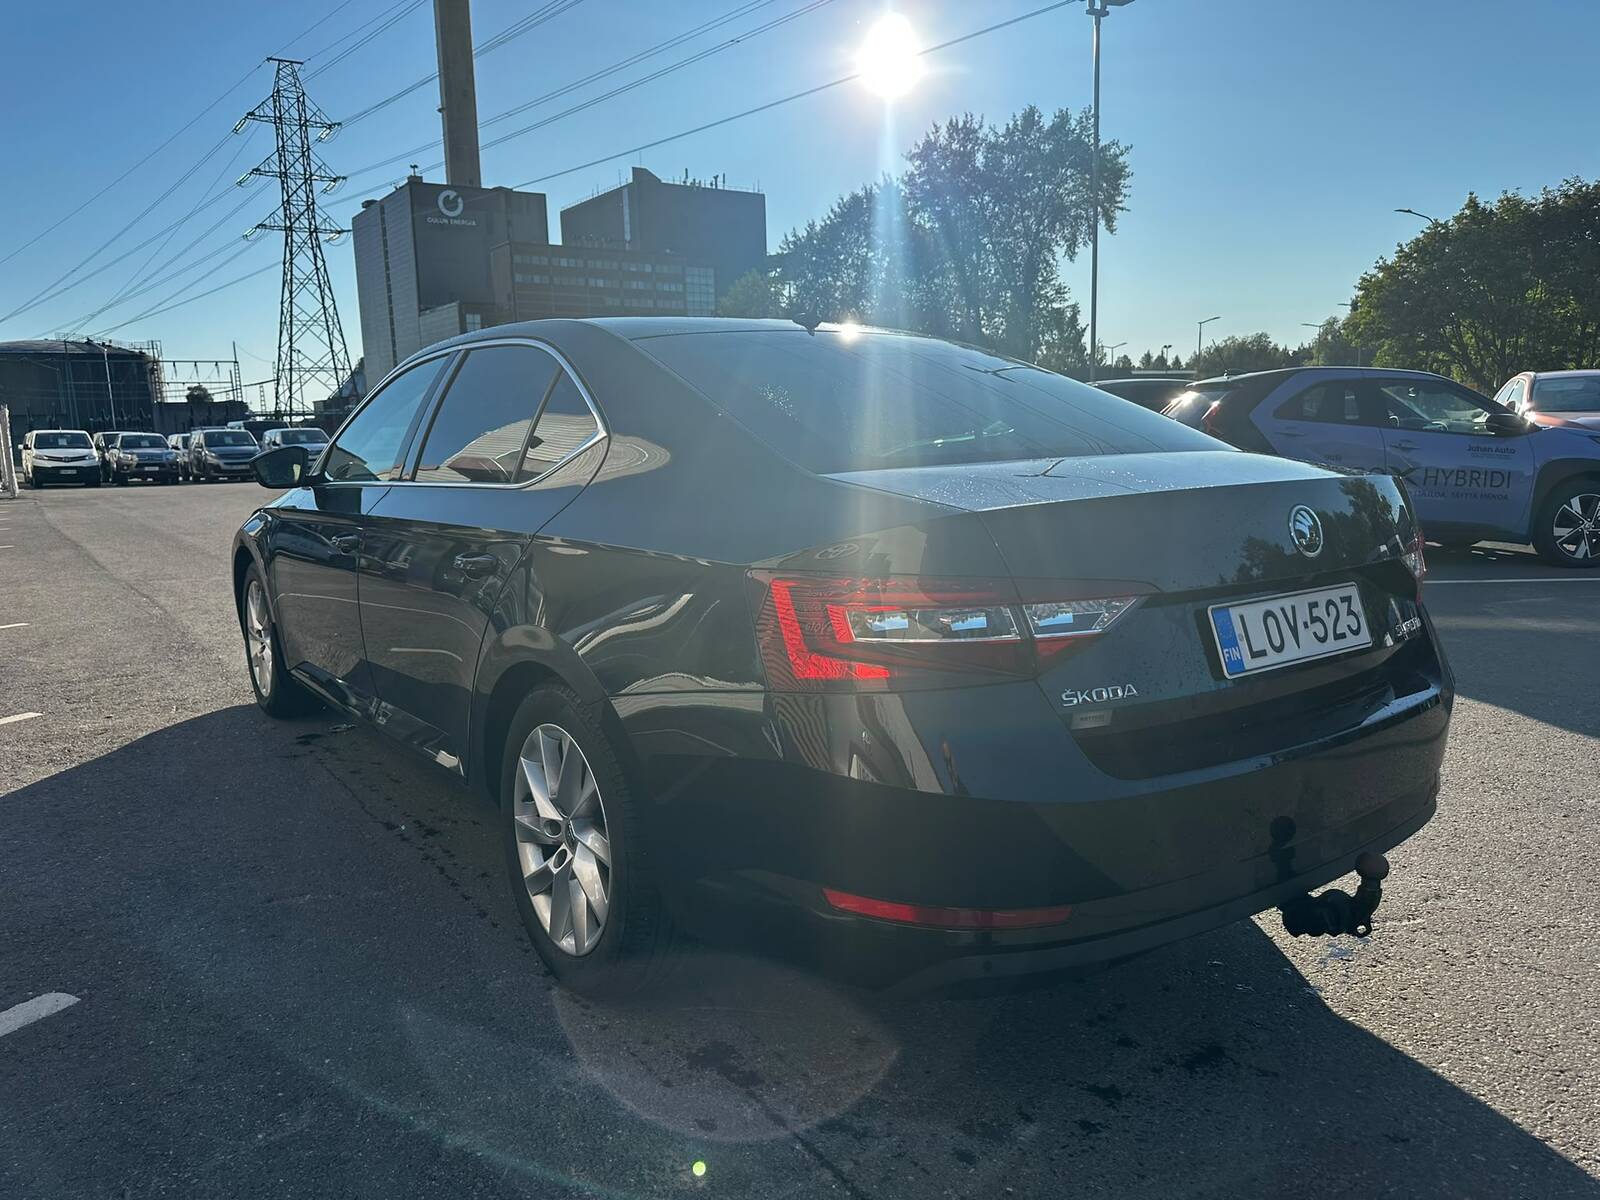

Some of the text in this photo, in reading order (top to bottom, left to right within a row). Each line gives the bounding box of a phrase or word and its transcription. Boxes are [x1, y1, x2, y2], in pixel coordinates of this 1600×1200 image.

[1423, 467, 1511, 489] HYBRIDI
[1238, 595, 1362, 659] LOV-523
[1223, 647, 1241, 663] FIN
[1061, 683, 1139, 707] ŠKODA
